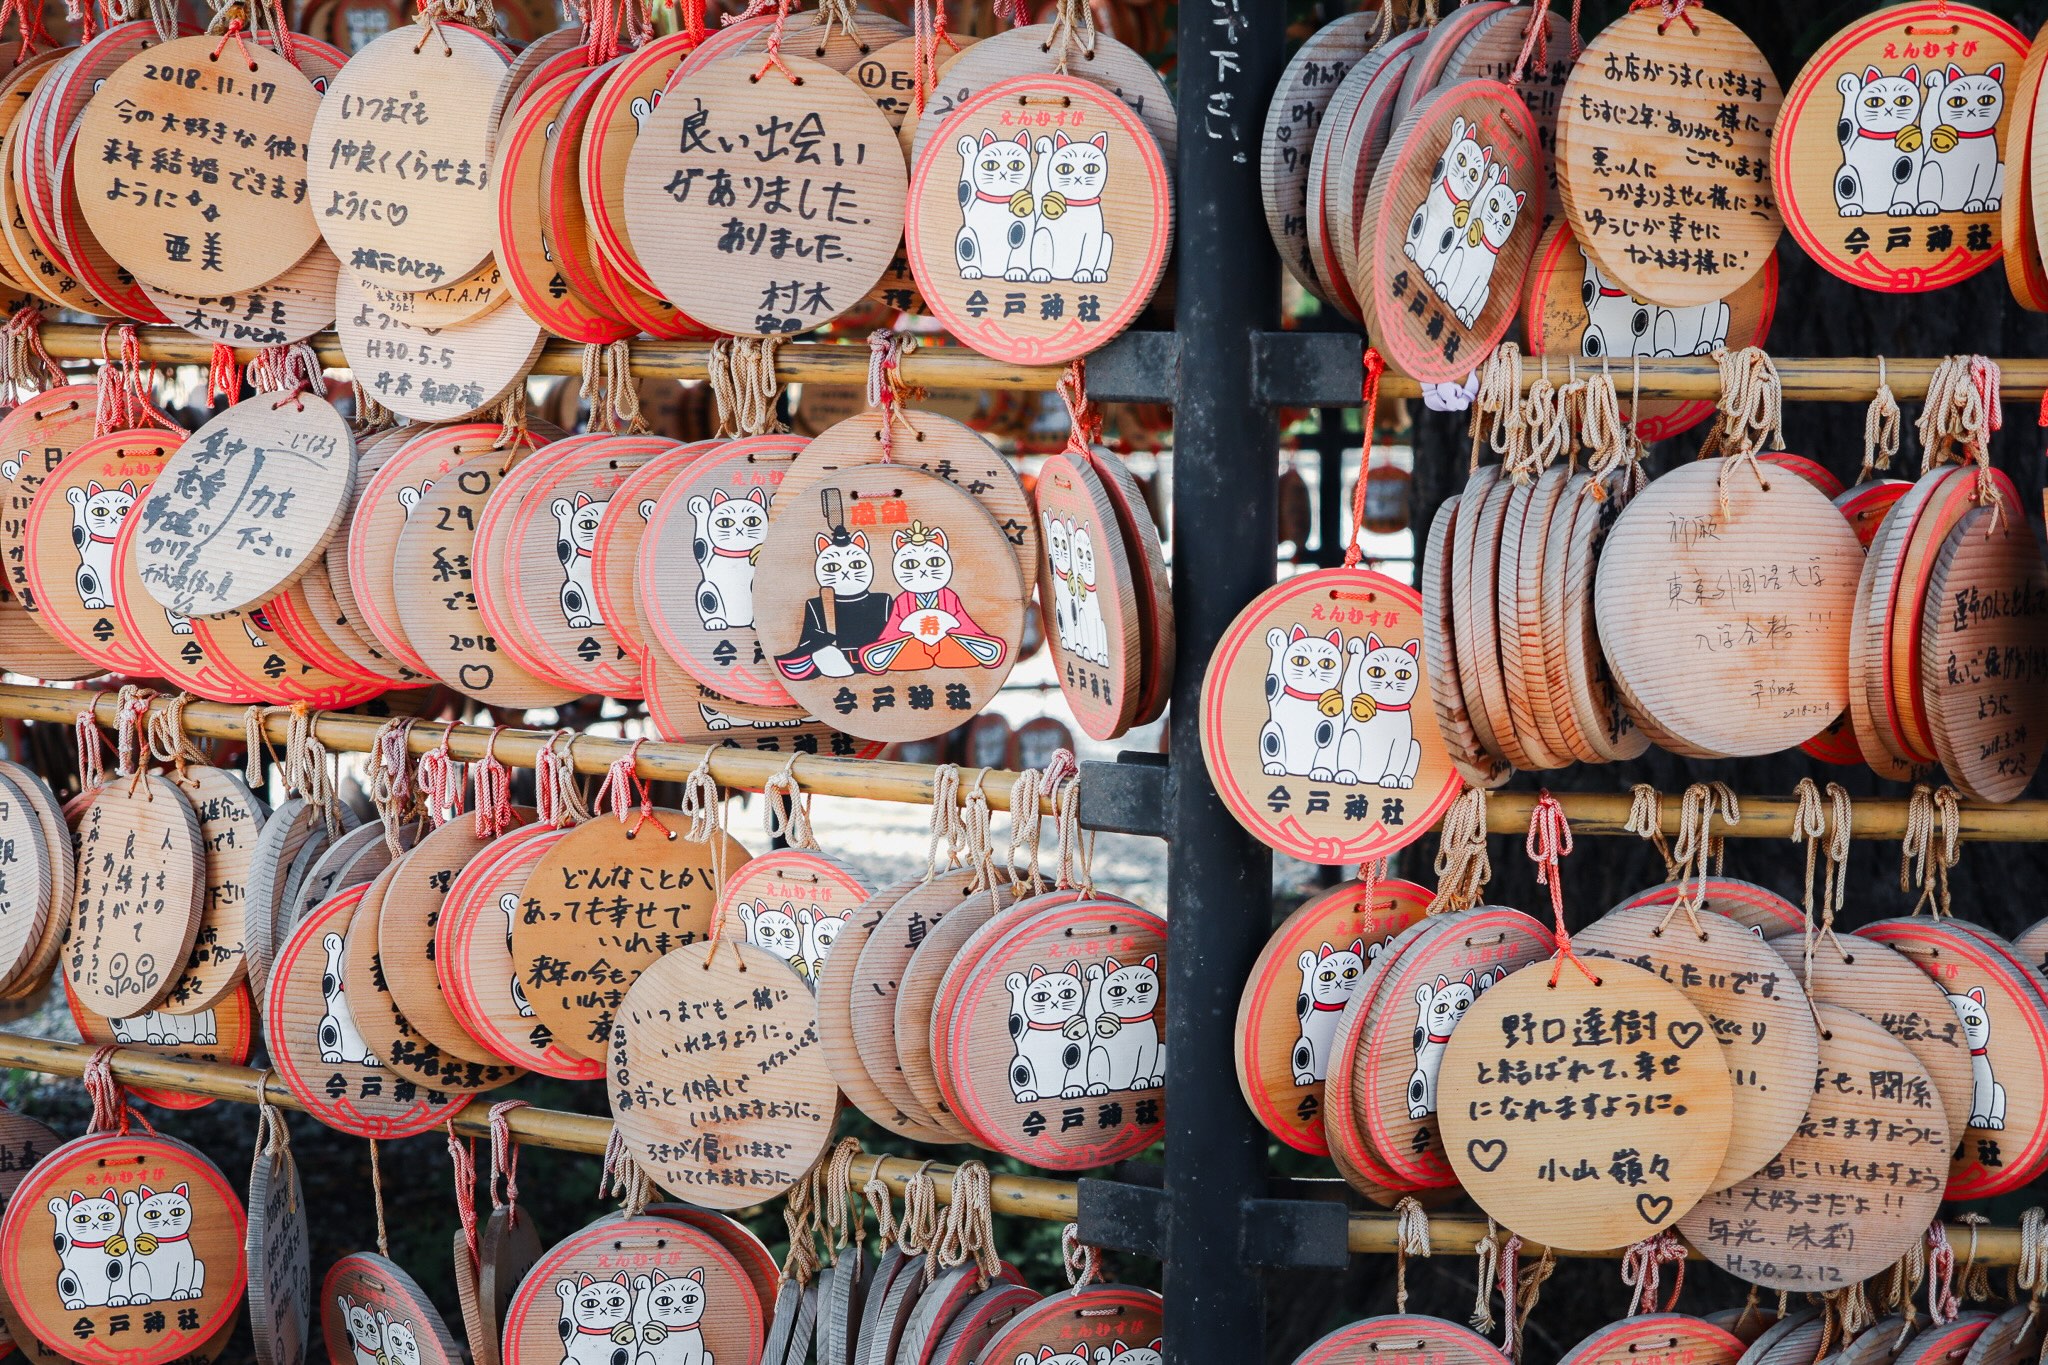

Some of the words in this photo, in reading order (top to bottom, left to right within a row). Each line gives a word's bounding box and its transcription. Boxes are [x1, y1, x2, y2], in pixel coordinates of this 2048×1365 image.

[1883, 40, 1979, 60] えんむすび
[143, 64, 276, 104] 2018.11.17
[1604, 52, 1766, 102] お店がうまくいきます
[341, 89, 429, 125] いつまでも
[1000, 109, 1086, 126] えんむすび
[680, 97, 866, 166] 良い出会い
[1592, 146, 1657, 178] 悪い人に
[106, 177, 178, 209] ように
[163, 232, 224, 272] 亜美
[1844, 224, 1993, 255] 今戸神社
[965, 290, 1101, 323] 今戸神社
[366, 339, 455, 369] H30.5.5
[237, 527, 293, 559] 下さい
[919, 615, 941, 636] 寿
[1310, 603, 1400, 628] えんむすび
[833, 683, 972, 714] 今戸神社
[1266, 784, 1406, 826] 今戸神社
[523, 894, 691, 929] あっても幸せで
[1048, 935, 1136, 958] えんむすび
[632, 986, 789, 1024] いつまでも一緒に
[1022, 1100, 1160, 1137] 今戸神社
[85, 1166, 166, 1186] えんむすび
[73, 1307, 201, 1340] 今戸神社
